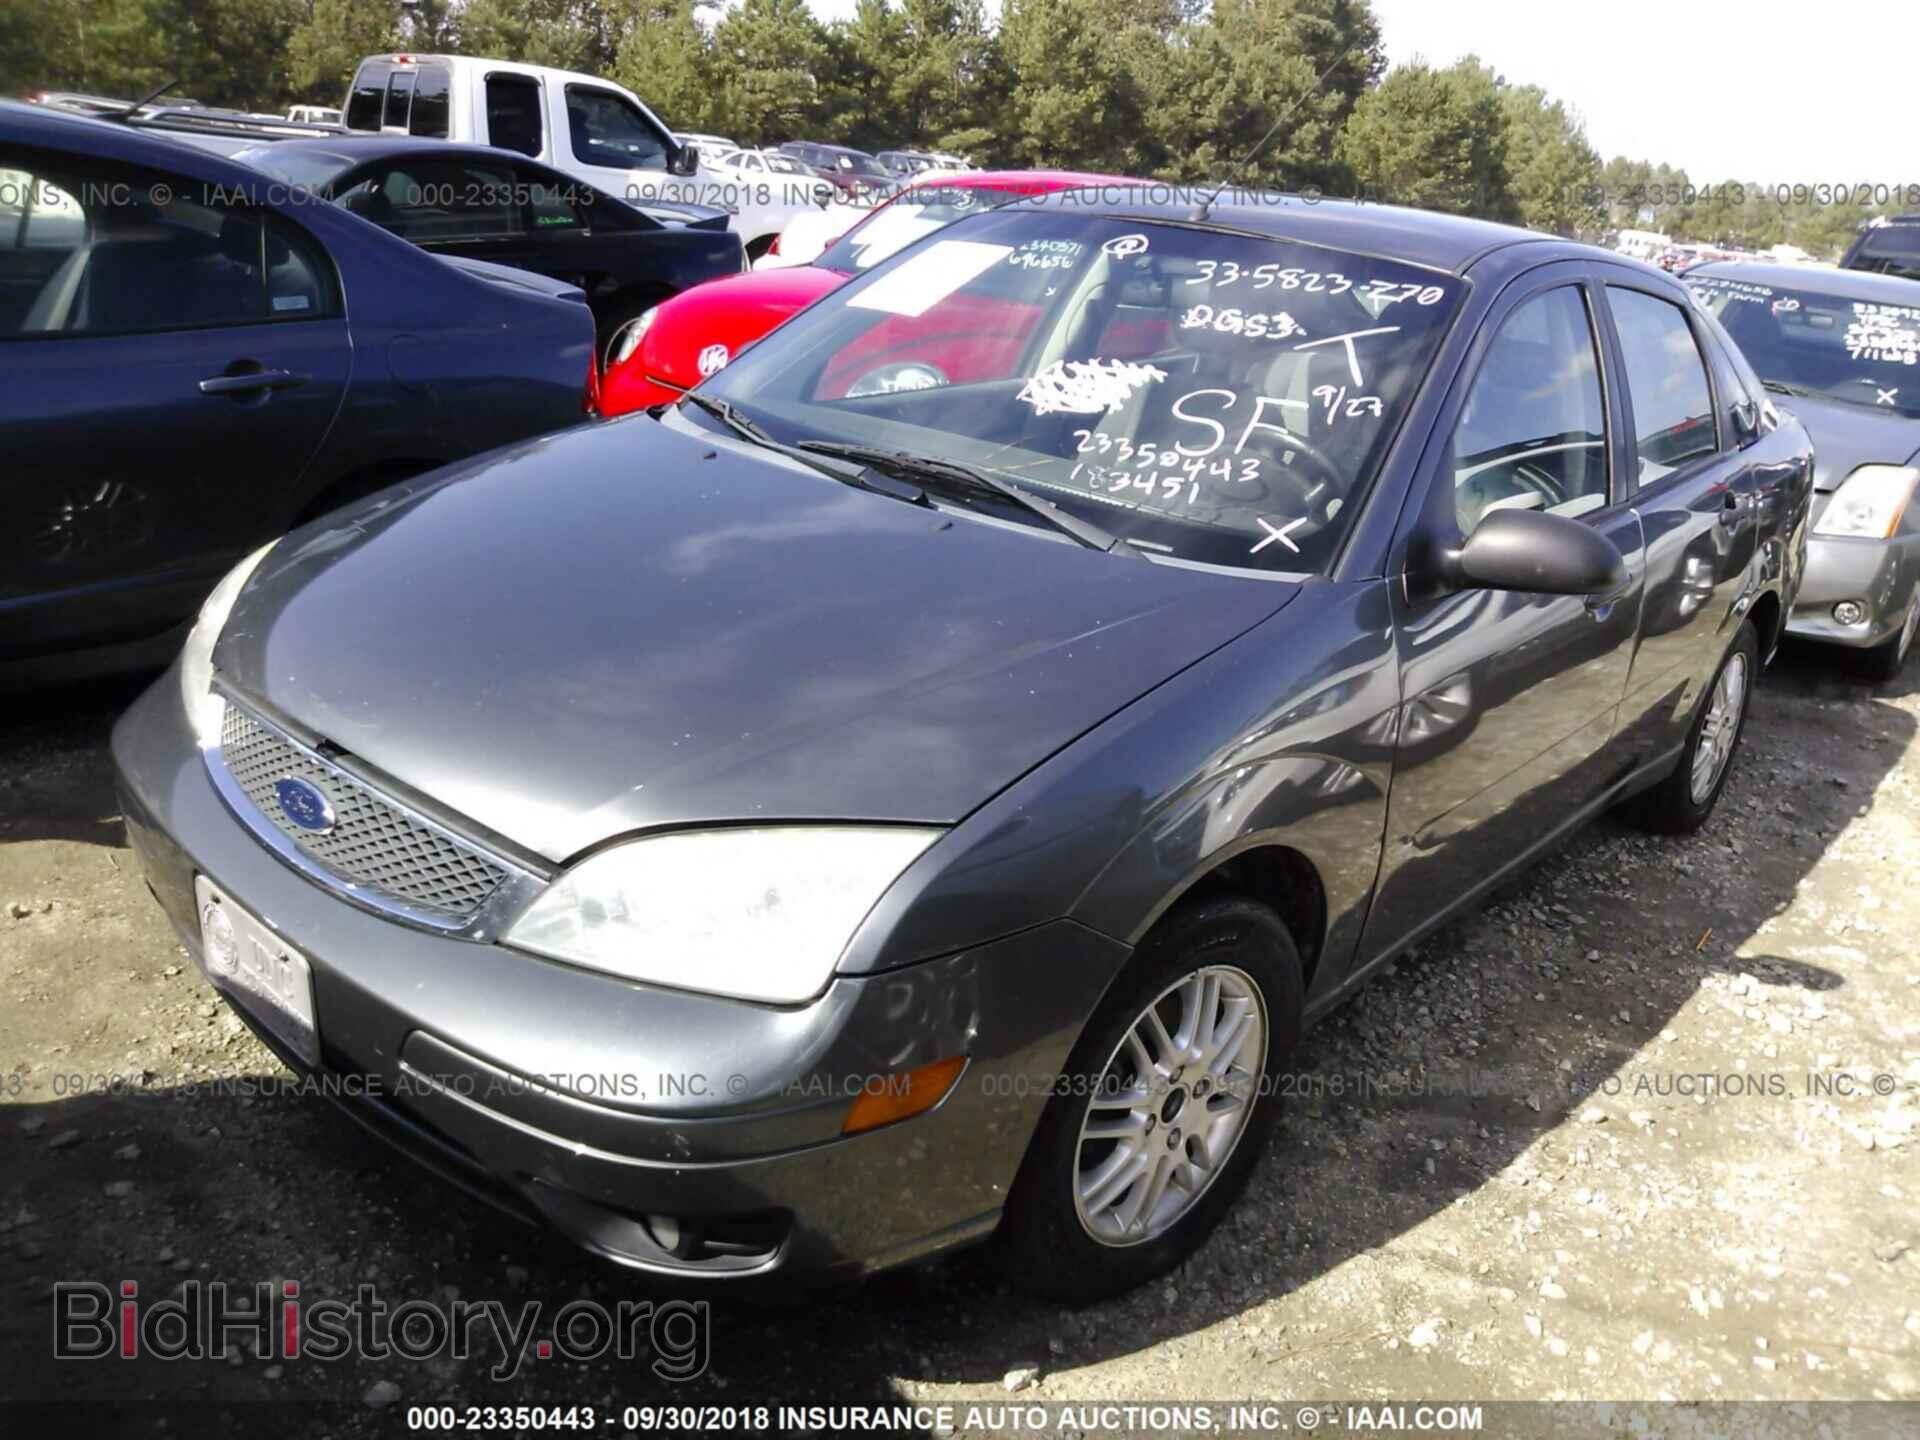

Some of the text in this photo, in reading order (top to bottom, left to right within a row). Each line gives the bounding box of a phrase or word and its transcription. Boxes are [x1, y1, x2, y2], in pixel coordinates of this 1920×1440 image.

[1292, 325, 1401, 387] T
[1311, 384, 1384, 425] 9/27
[1073, 430, 1261, 482] 23350443
